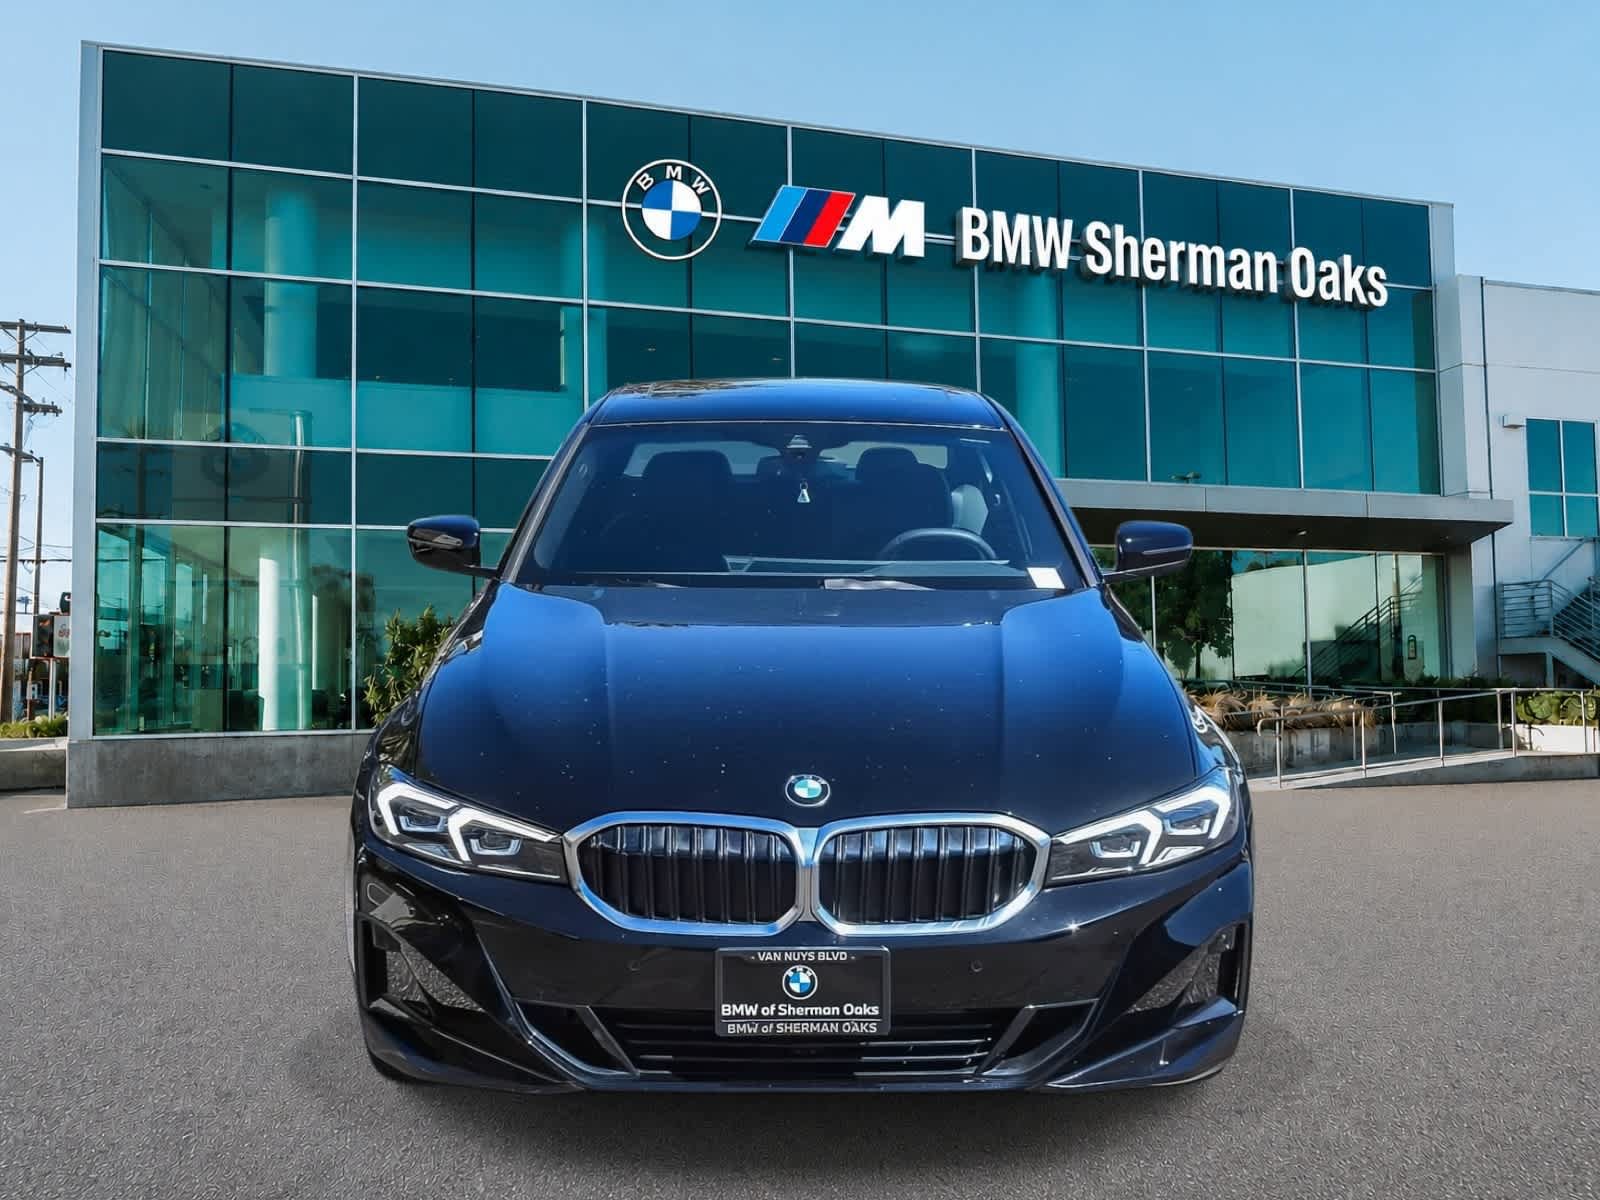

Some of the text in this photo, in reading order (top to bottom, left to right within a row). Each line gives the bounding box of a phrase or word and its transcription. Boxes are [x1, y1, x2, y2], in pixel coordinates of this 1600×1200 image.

[636, 165, 711, 196] BMW
[834, 195, 925, 258] M
[960, 206, 1389, 307] BMW Sherman Oaks
[757, 952, 848, 961] VAN NUYS BLVD
[721, 1003, 879, 1016] BMW of Sherman Oaks
[727, 1022, 878, 1034] BMW of SHERMAN OAKS
